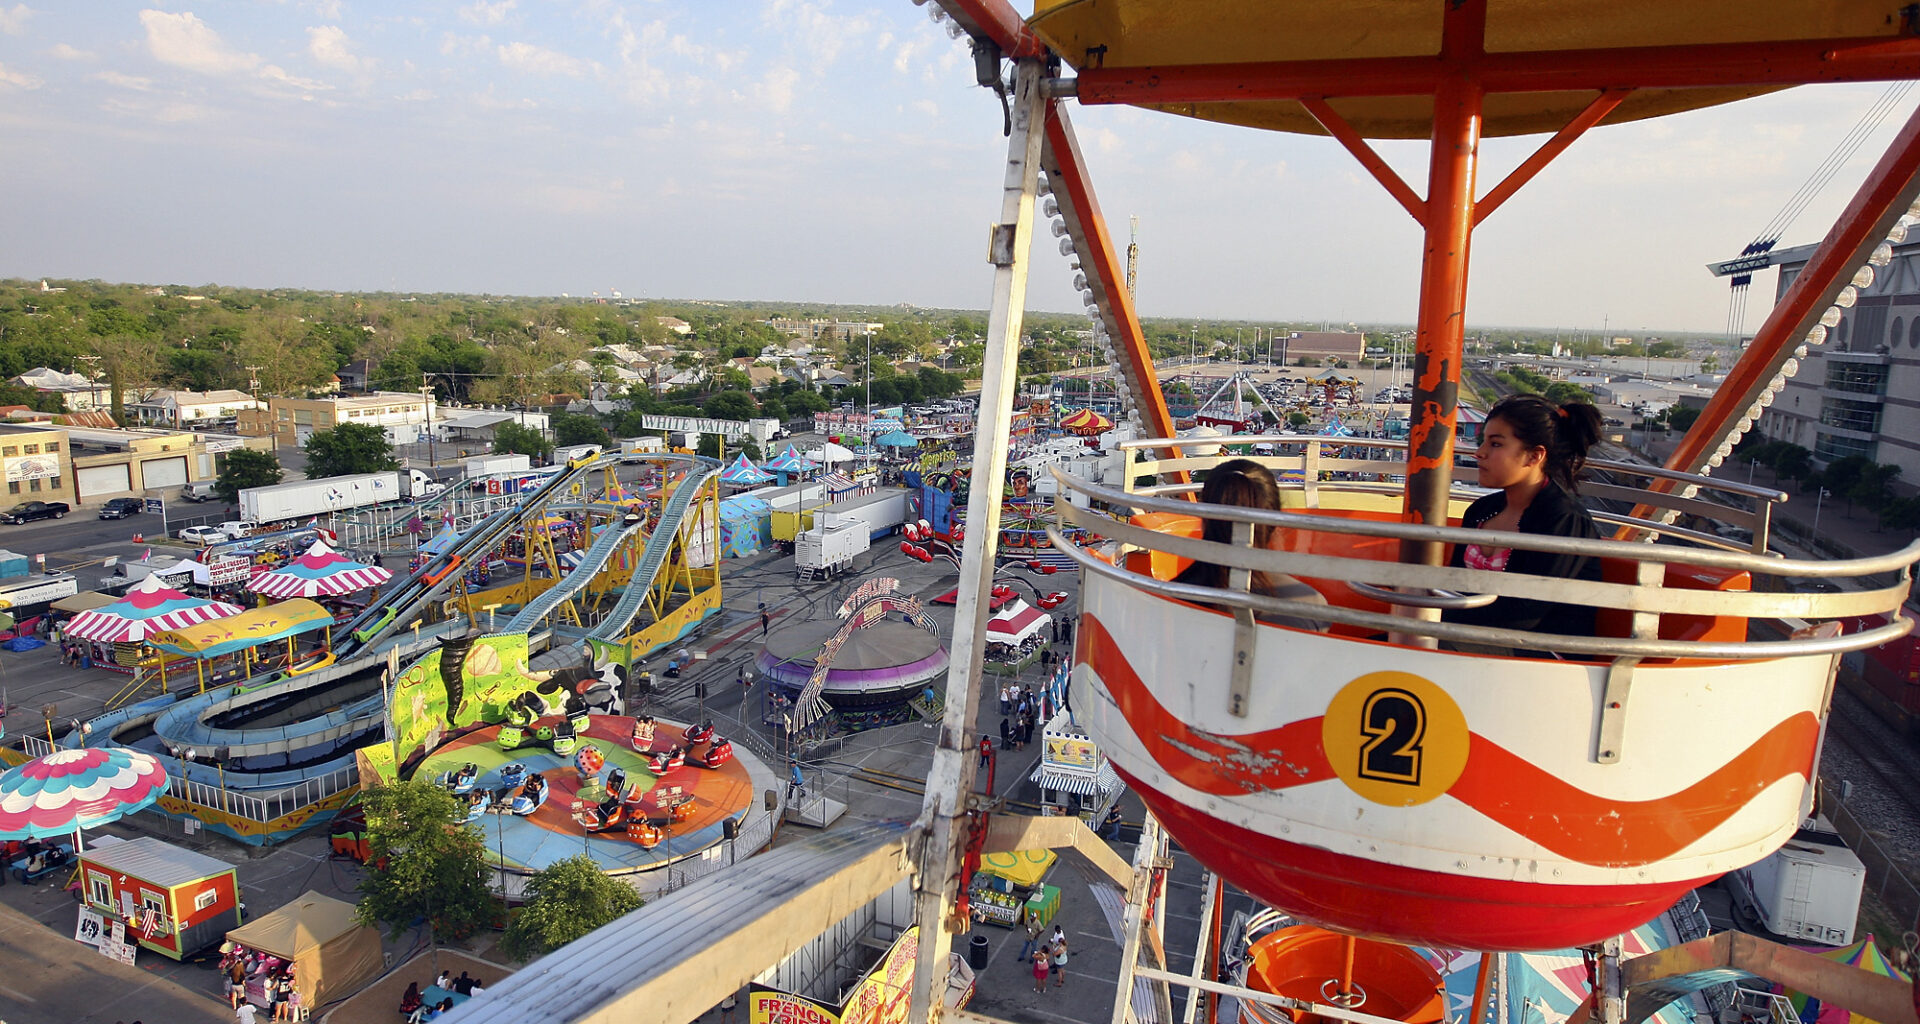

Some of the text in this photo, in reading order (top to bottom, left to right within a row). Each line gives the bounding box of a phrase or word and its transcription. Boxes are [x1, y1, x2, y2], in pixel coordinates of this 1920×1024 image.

[643, 414, 741, 435] WHITE WATER
[209, 557, 250, 571] AGUAS FRESCAS
[31, 589, 54, 598] Antonio
[55, 585, 73, 593] Police
[1358, 687, 1427, 786] 2
[758, 999, 832, 1024] FRENCH
